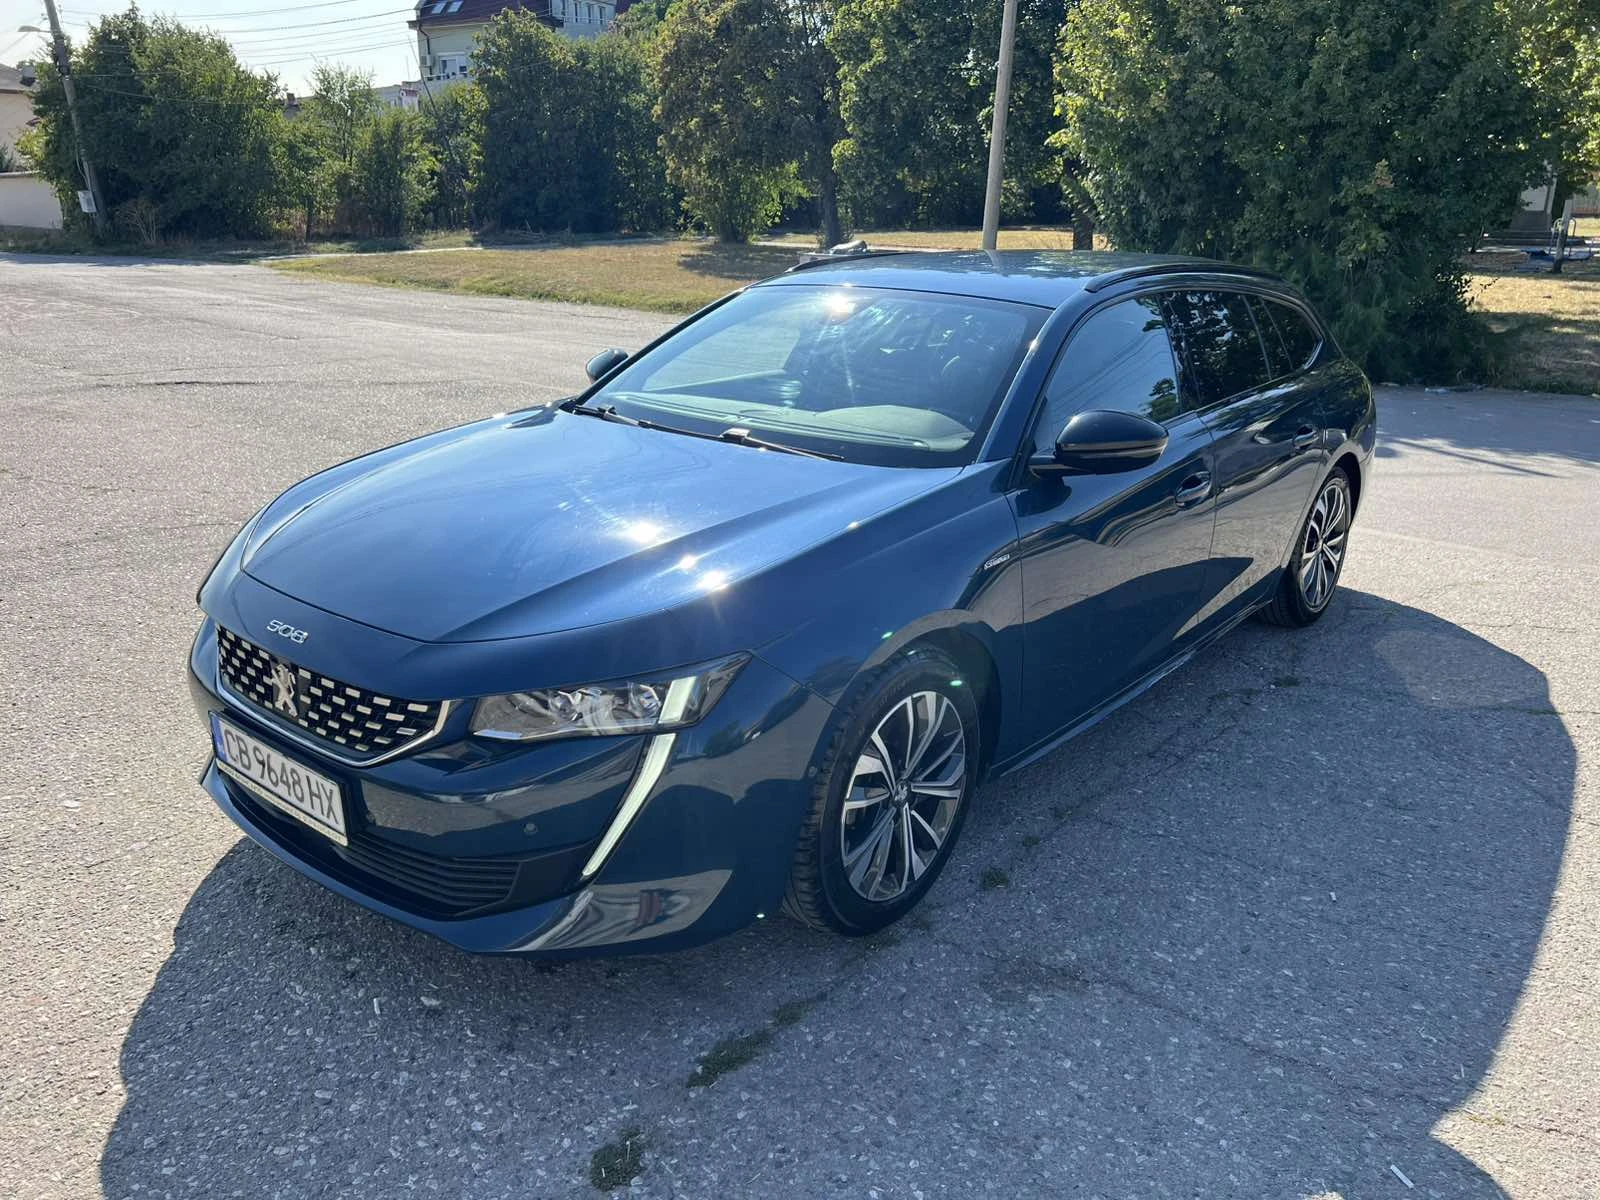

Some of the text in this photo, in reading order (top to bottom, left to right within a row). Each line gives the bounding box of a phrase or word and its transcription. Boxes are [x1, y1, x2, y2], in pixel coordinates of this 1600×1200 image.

[267, 619, 308, 643] 508
[224, 729, 252, 771] CB
[254, 746, 304, 803] 9648
[306, 775, 339, 825] HX
